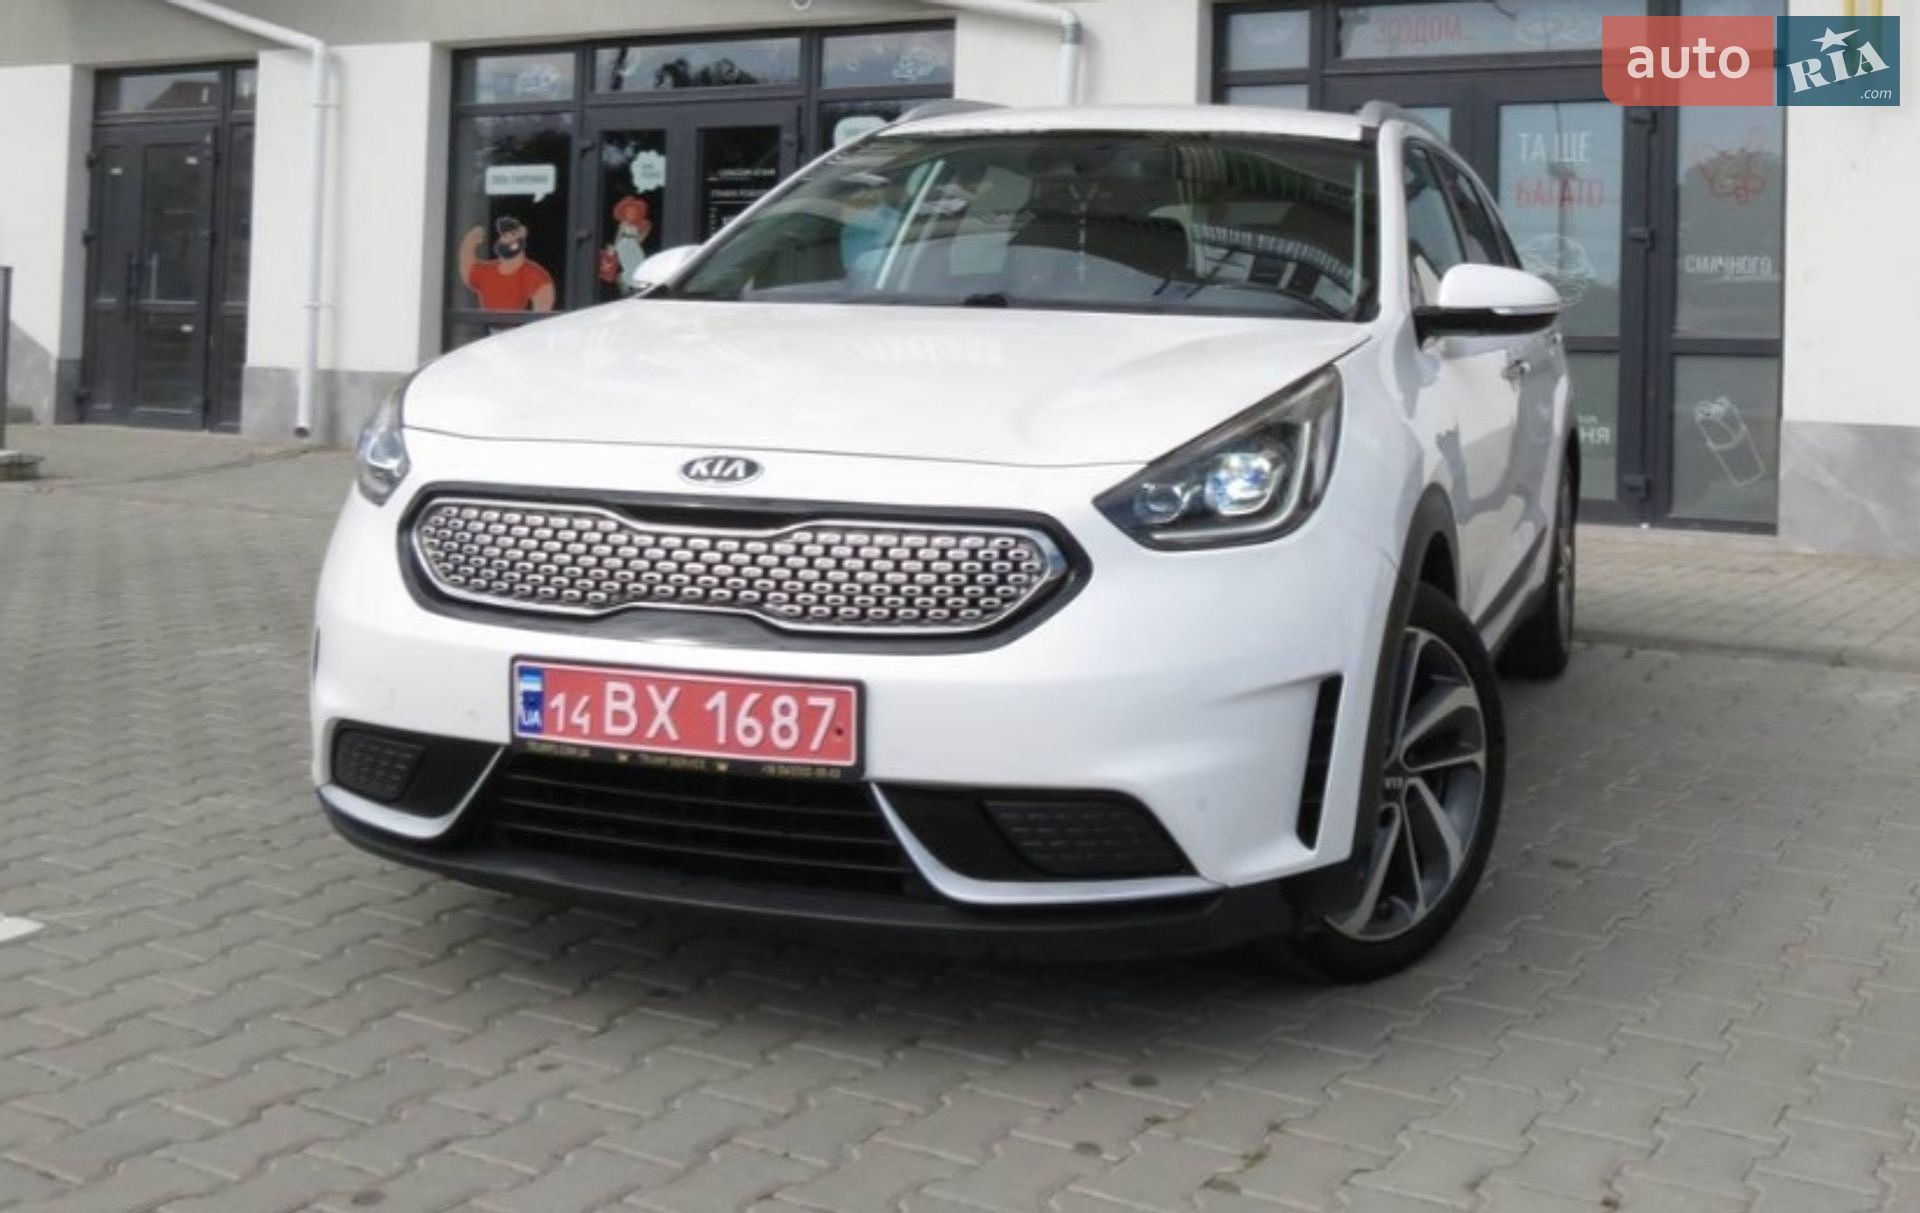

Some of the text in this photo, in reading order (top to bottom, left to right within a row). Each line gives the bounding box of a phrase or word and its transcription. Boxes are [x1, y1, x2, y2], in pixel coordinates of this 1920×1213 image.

[1517, 133, 1547, 163] ТА
[689, 459, 745, 477] KIA
[550, 680, 836, 751] 14 BX 1687
